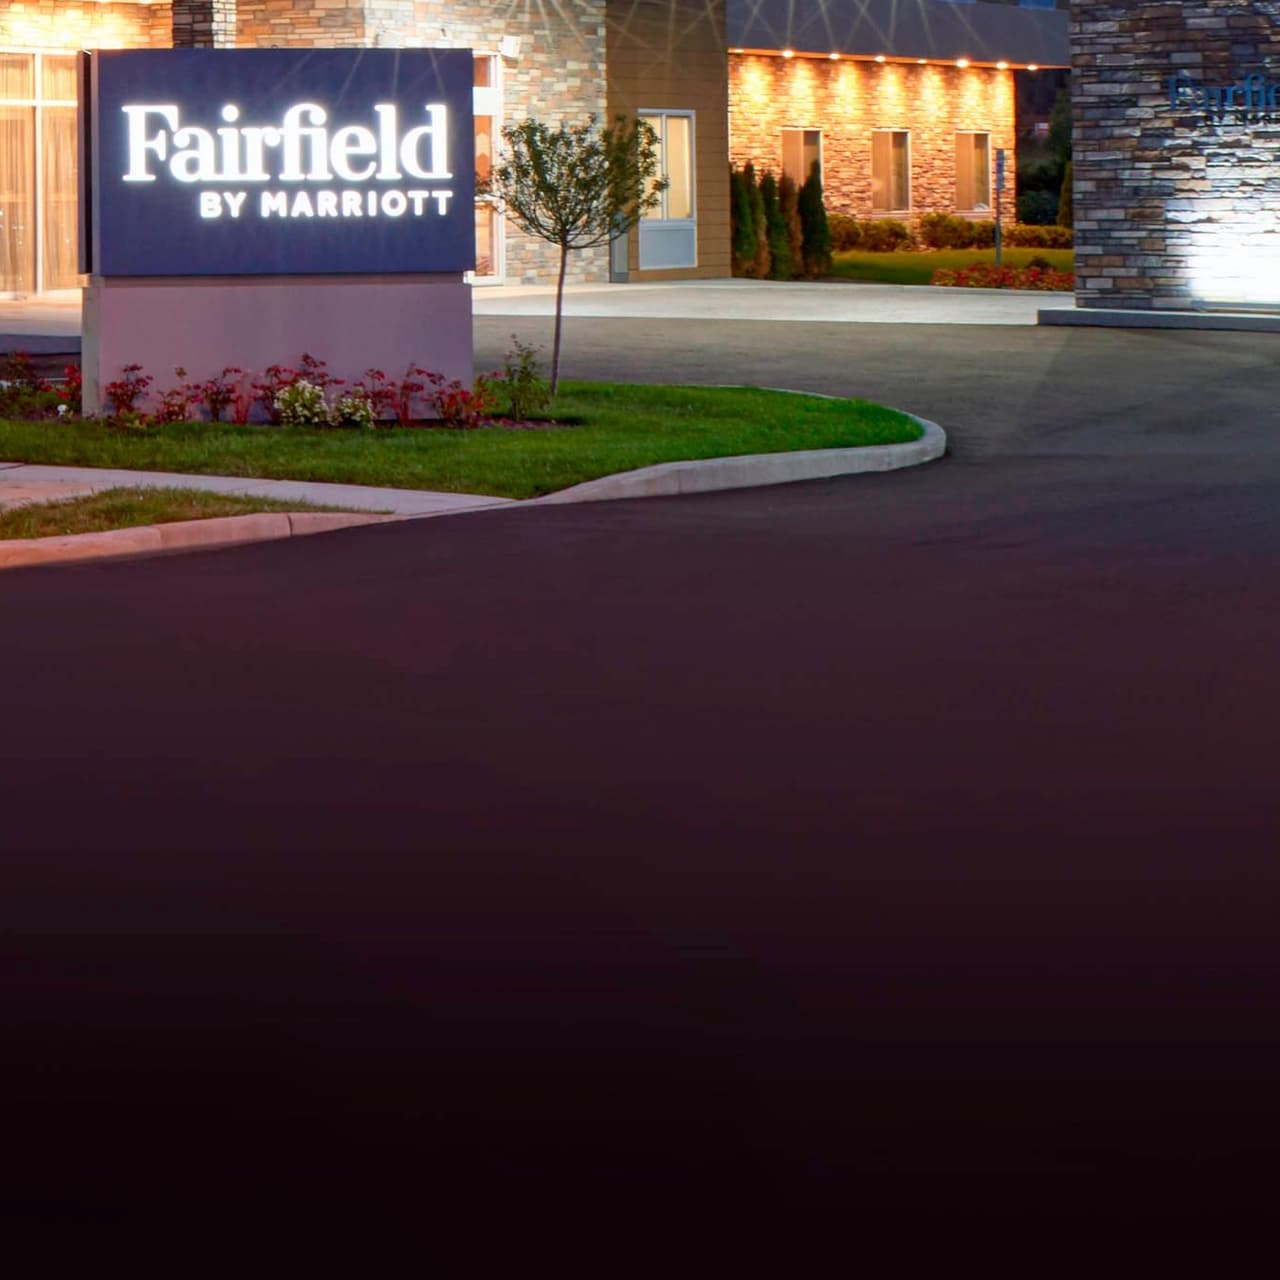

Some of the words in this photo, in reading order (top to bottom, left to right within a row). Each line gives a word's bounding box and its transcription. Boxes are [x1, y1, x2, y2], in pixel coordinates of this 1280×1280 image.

[121, 102, 454, 183] Fairfield
[200, 190, 247, 219] BY
[260, 190, 454, 219] MARRIOTT
